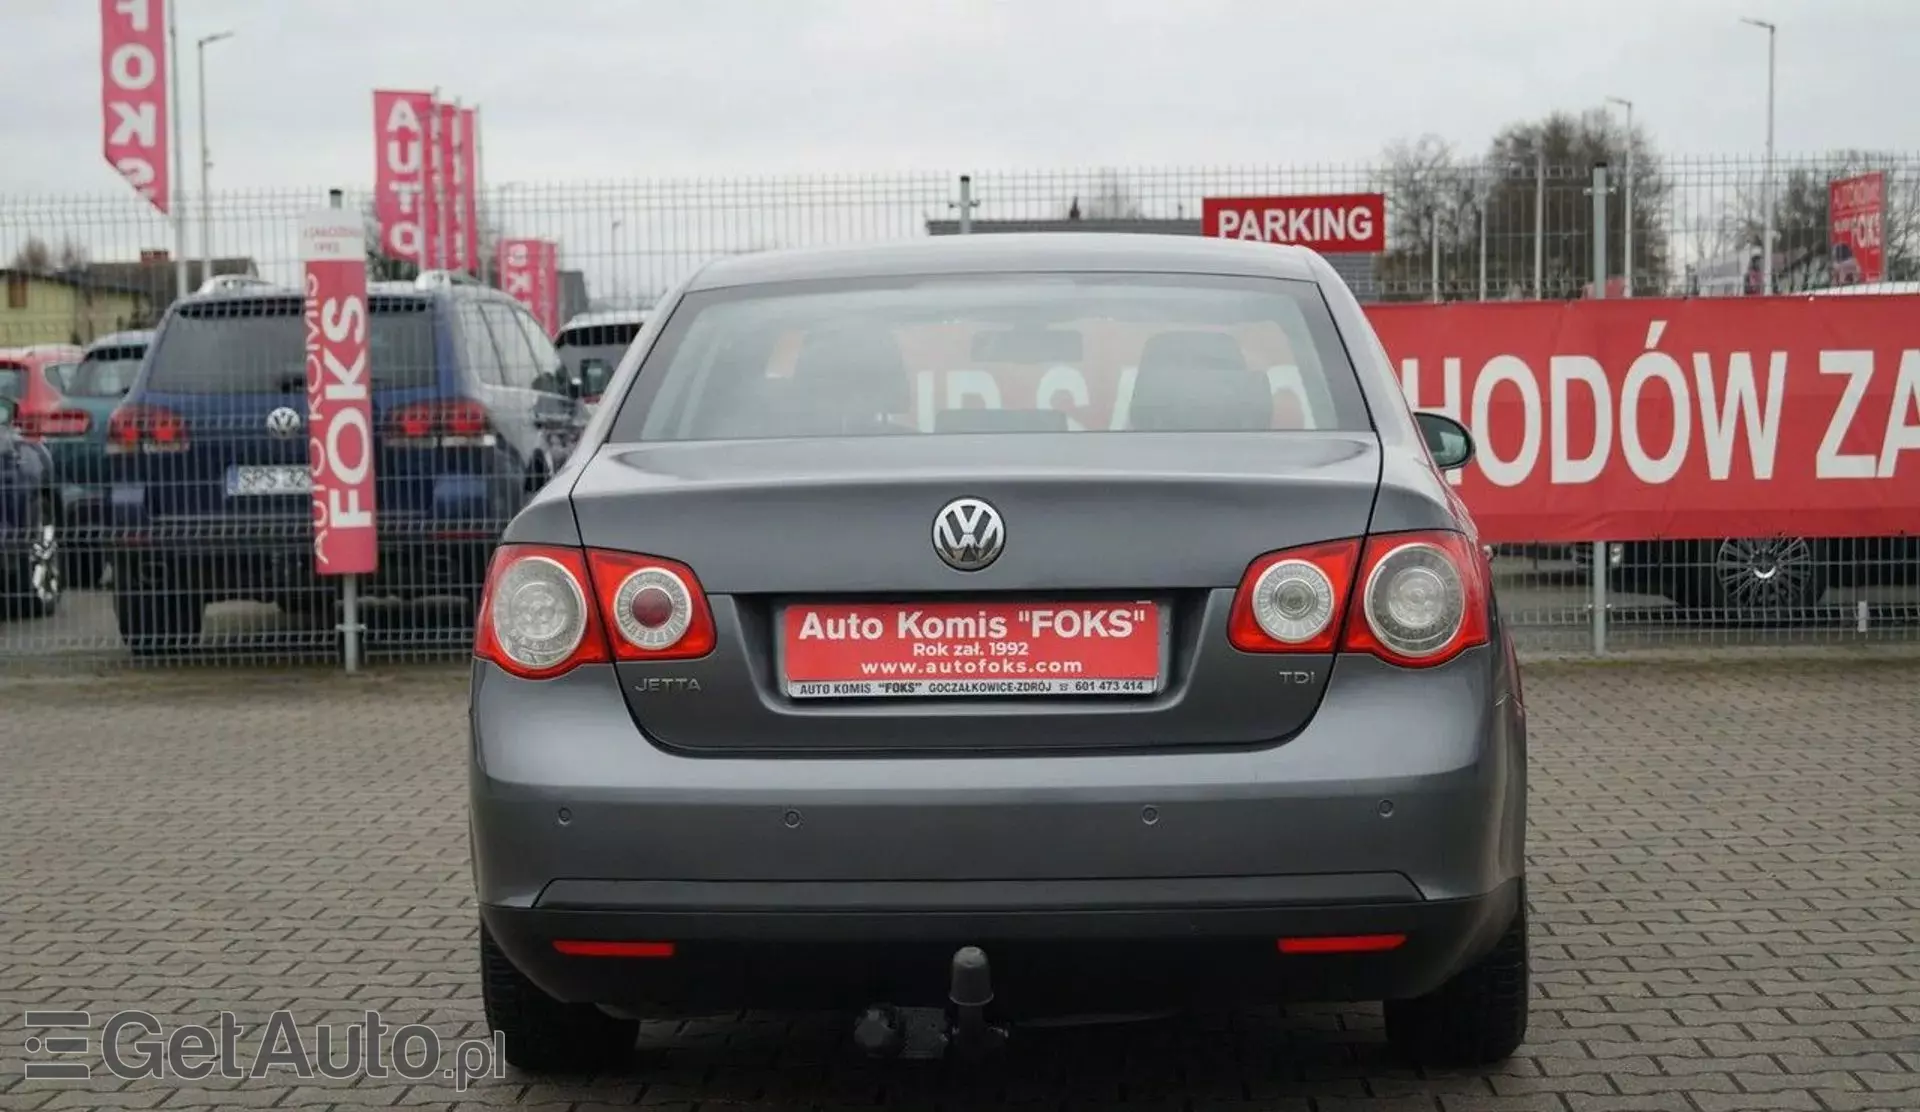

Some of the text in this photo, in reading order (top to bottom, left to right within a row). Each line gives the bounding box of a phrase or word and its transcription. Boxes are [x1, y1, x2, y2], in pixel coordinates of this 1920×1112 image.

[1218, 206, 1373, 242] PARKING
[321, 295, 373, 528] FOKS
[1402, 320, 1789, 487] HODÓW
[799, 608, 1146, 641] Auto Komis "FOKS"
[913, 641, 1029, 657] Rok zał. 1992
[861, 657, 1084, 675] www.autofoks.com
[634, 678, 701, 692] JETTA
[1279, 671, 1315, 684] TDI
[800, 683, 830, 695] AUTO
[833, 682, 872, 695] KOMIS
[928, 679, 1053, 693] GOCZAŁKOWICE-ZDRÓJ
[1075, 681, 1095, 691] 601
[1099, 680, 1120, 691] 473
[1122, 681, 1144, 691] 414
